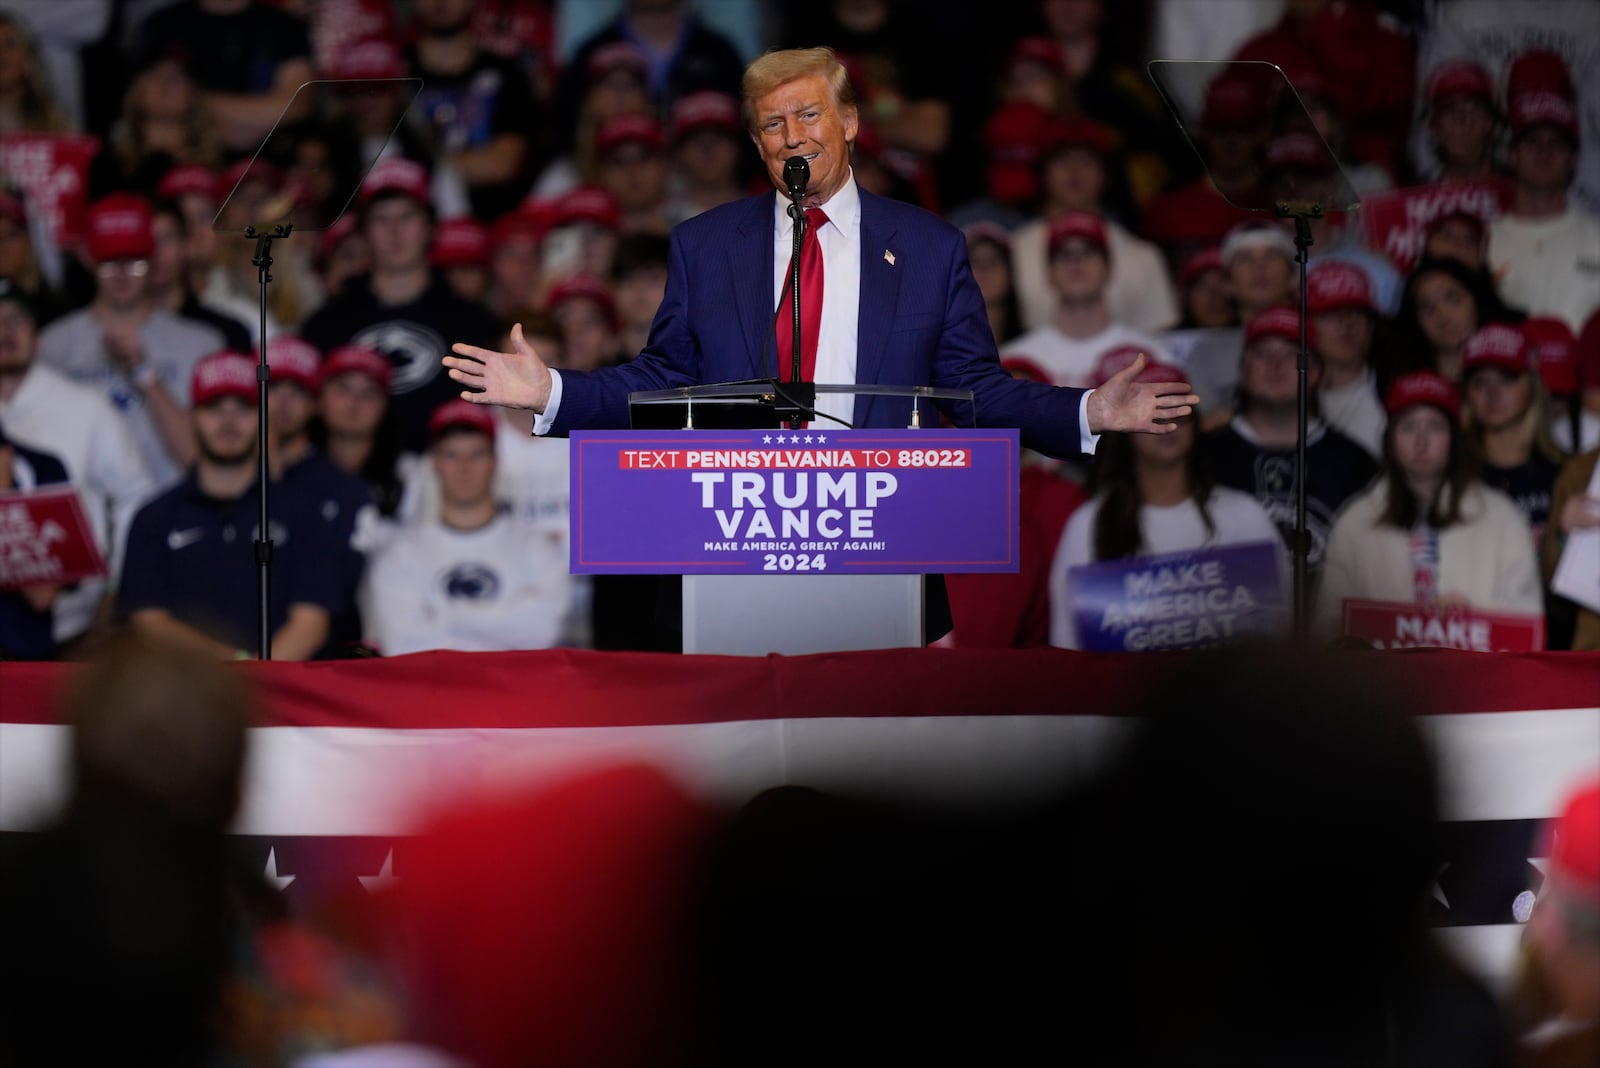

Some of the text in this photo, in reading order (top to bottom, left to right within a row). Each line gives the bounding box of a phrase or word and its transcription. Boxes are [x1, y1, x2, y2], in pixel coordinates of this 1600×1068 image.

[624, 449, 966, 468] TEXT PENNSYLVANIA TO 88022
[691, 472, 898, 508] TRUMP
[714, 509, 874, 538] VANCE
[704, 541, 885, 551] MAKE AMERICA GREAT AGAIN!
[763, 553, 827, 571] 2024
[1123, 561, 1222, 598] MAKE
[1101, 585, 1255, 631] AMERICA
[1122, 614, 1236, 651] GREAT
[1395, 615, 1491, 652] MAKE
